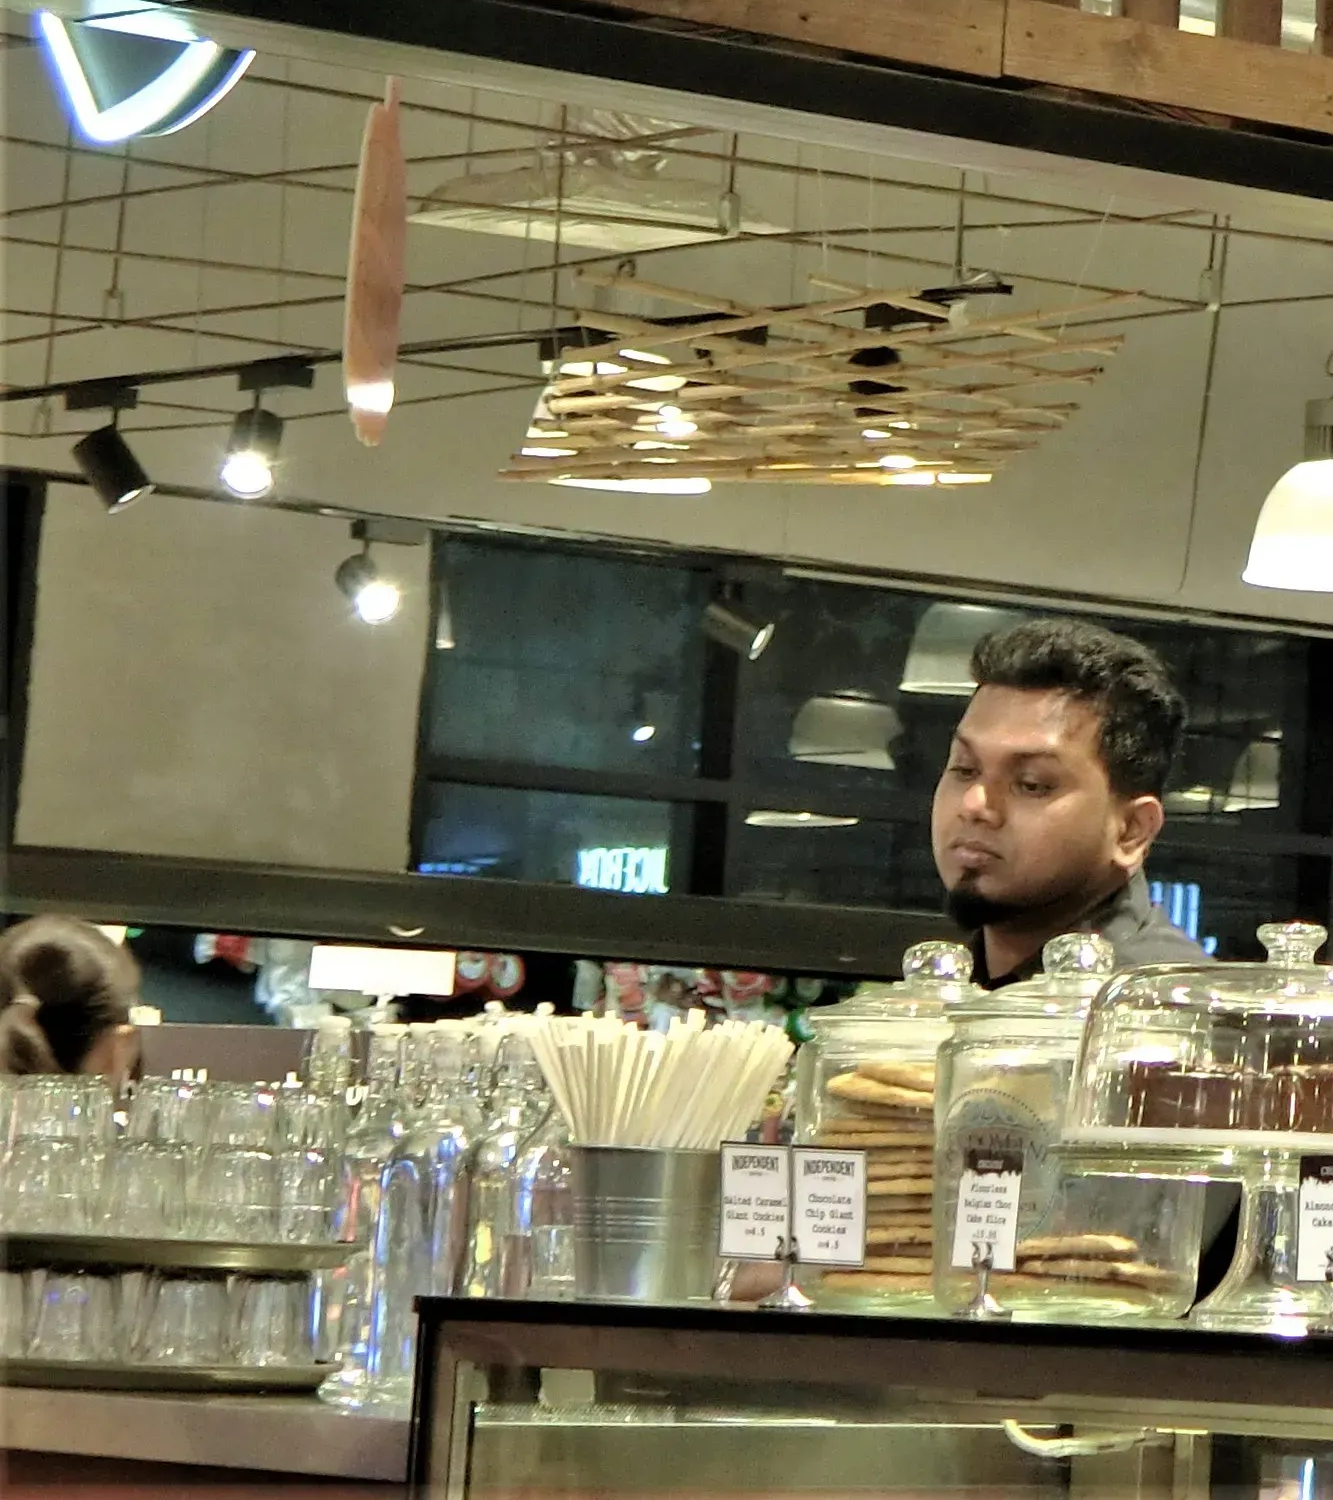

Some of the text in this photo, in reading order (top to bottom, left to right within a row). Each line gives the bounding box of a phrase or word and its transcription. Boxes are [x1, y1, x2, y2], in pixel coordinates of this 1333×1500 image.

[731, 1155, 779, 1173] INDEPENDENT
[803, 1159, 856, 1177] INDEPENDENT
[808, 1193, 852, 1205] Chocolate
[753, 1212, 785, 1222] Cookies
[1312, 1218, 1333, 1228] Cake
[812, 1225, 847, 1235] Cookies
